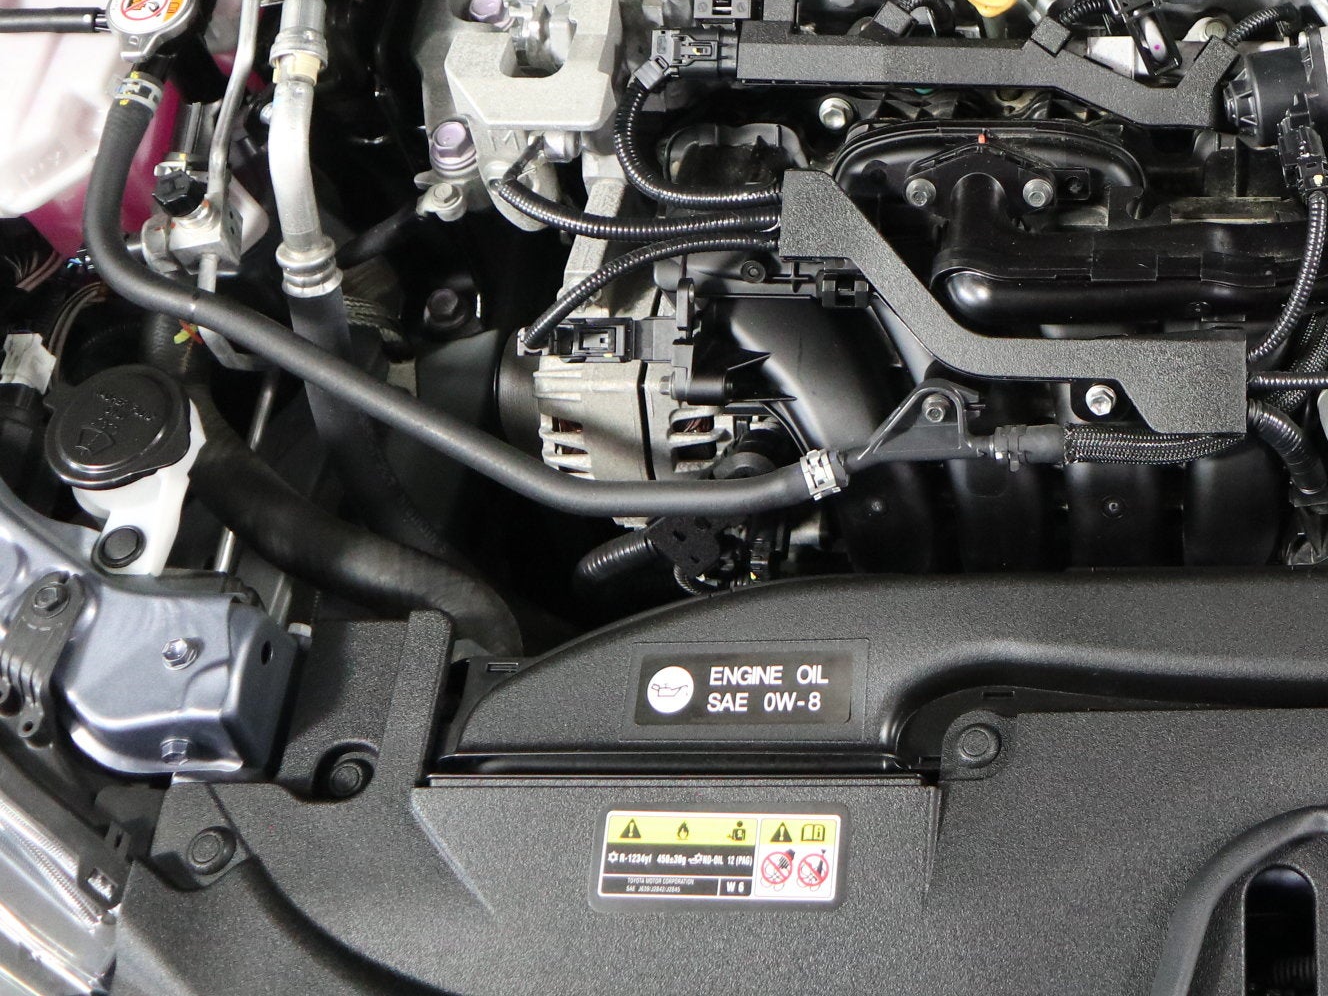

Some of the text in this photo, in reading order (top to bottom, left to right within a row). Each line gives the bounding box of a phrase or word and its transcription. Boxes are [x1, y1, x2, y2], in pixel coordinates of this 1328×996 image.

[709, 664, 829, 685] ENGINE OIL
[706, 691, 821, 712] SAE 0W-8
[736, 855, 753, 867] (PAG)
[627, 876, 645, 884] TOYOTA
